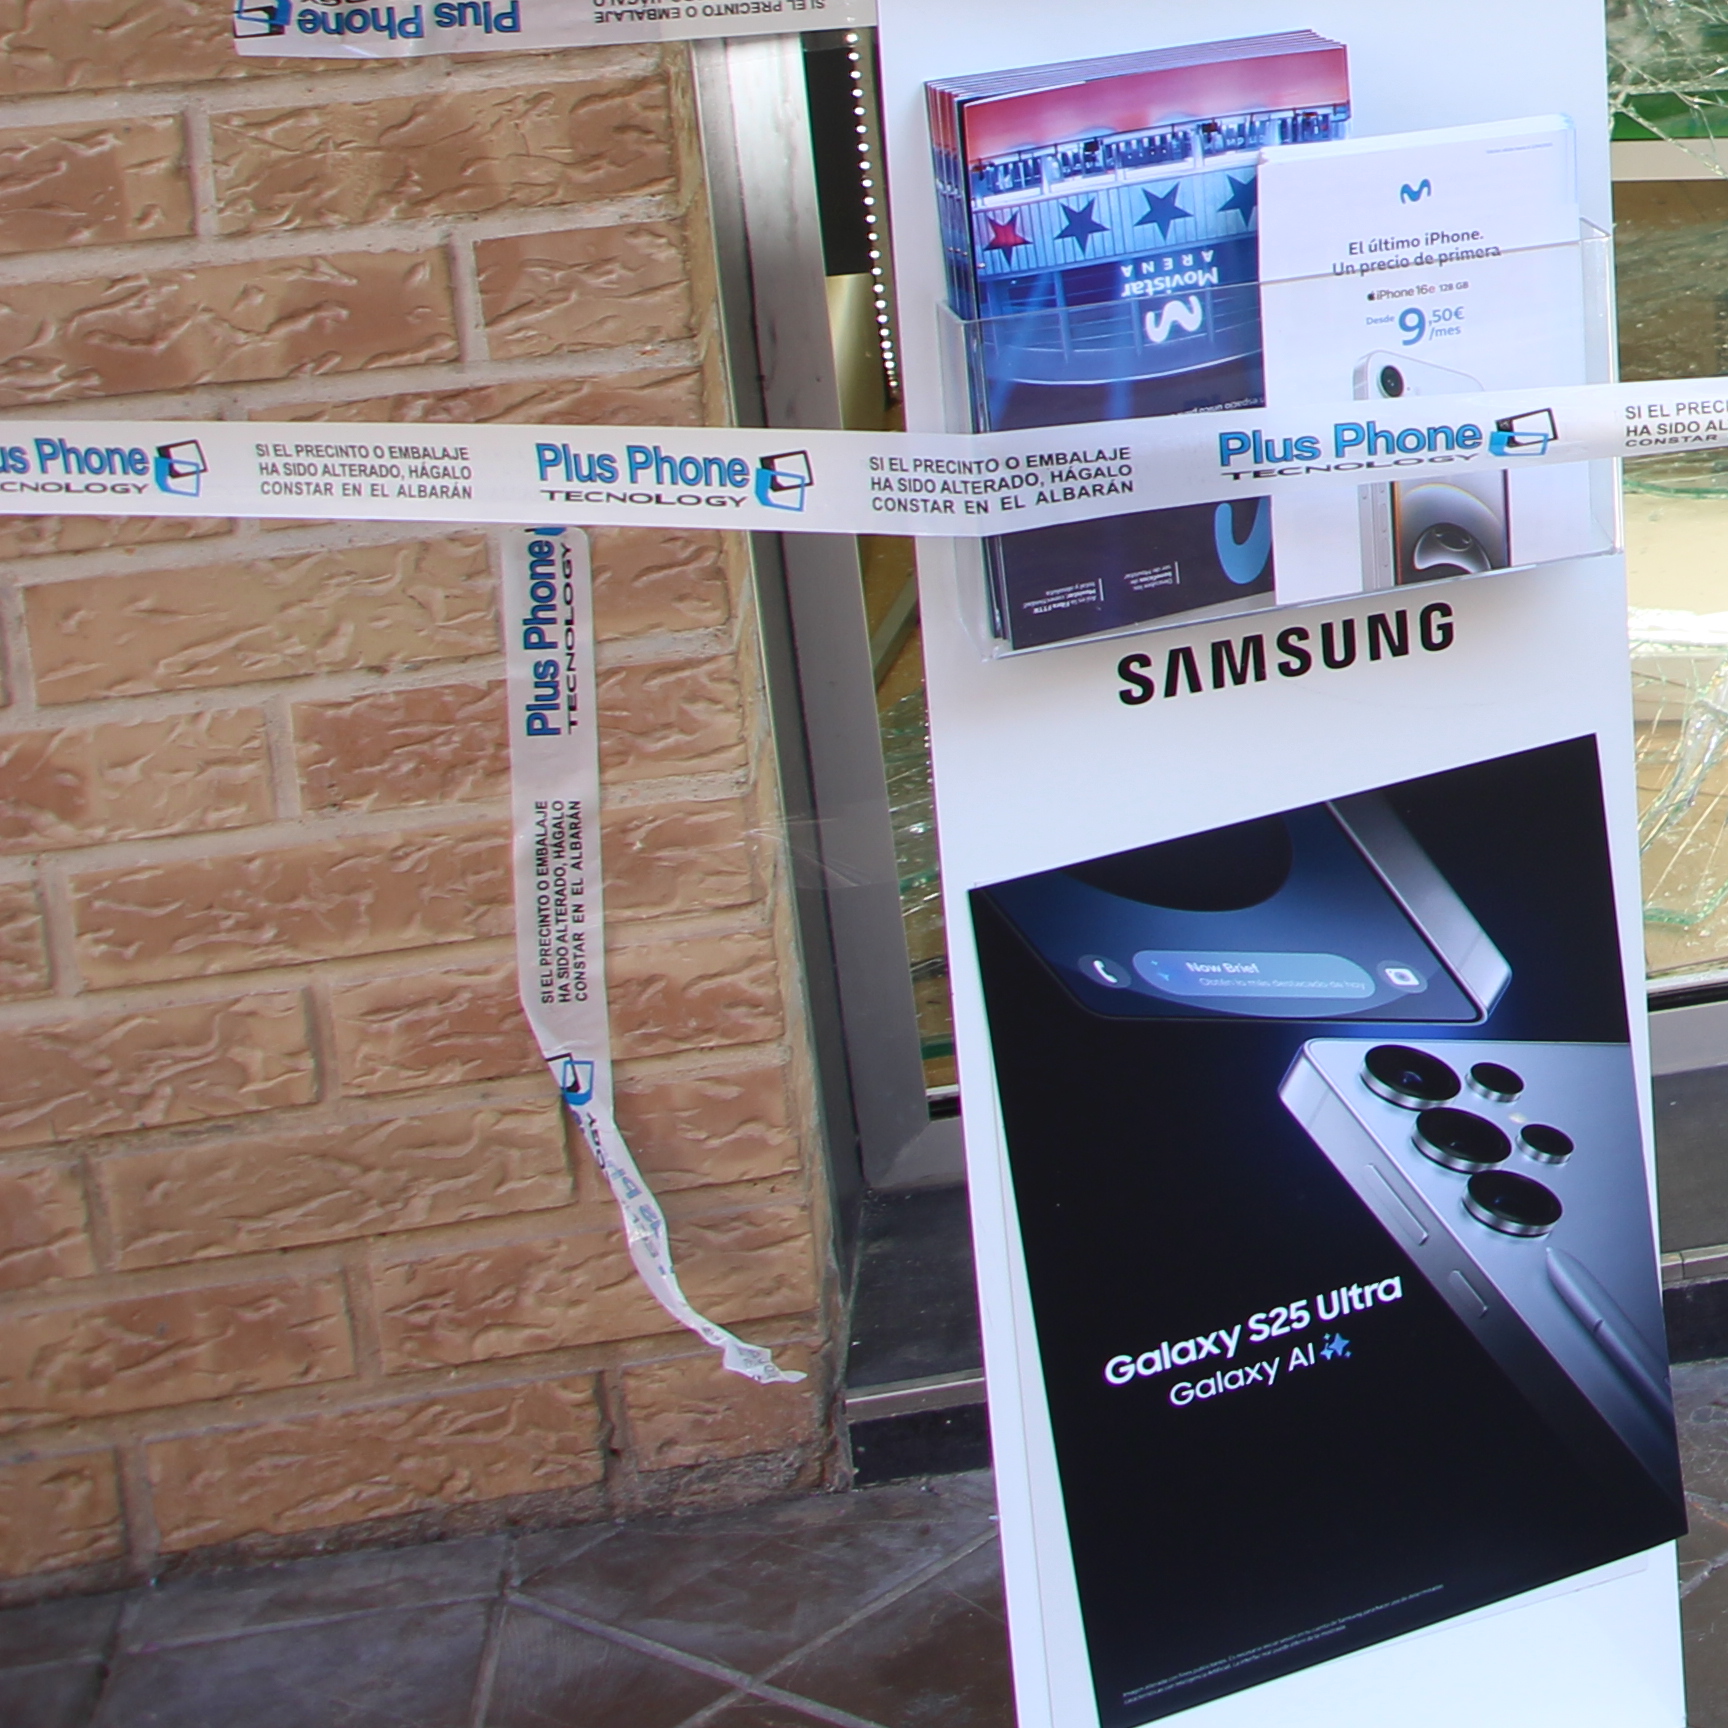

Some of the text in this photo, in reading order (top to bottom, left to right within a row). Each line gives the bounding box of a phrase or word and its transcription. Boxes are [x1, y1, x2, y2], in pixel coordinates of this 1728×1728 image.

[1349, 230, 1484, 255] El último iPhone.
[1333, 246, 1501, 277] Un precio de primera
[1121, 266, 1218, 297] Movistar
[1376, 281, 1468, 300] iPhone 16e 128 GB
[1366, 314, 1395, 325] Desde
[1398, 308, 1426, 346] 9
[1429, 325, 1461, 341] /mes
[256, 444, 470, 460] SI EL PRECINTO O EMBALAJE
[534, 442, 751, 489] Plus Phone
[259, 462, 472, 480] HA SIDO ALTERADO, HÁGALO
[261, 481, 472, 499] CONSTAR EN EL ALBARÁN
[540, 489, 748, 508] TECNOLOGY
[1117, 601, 1455, 705] SAMSUNG
[1104, 1275, 1403, 1385] Galaxy S25 Ultra
[1169, 1342, 1316, 1406] Galaxy AI
